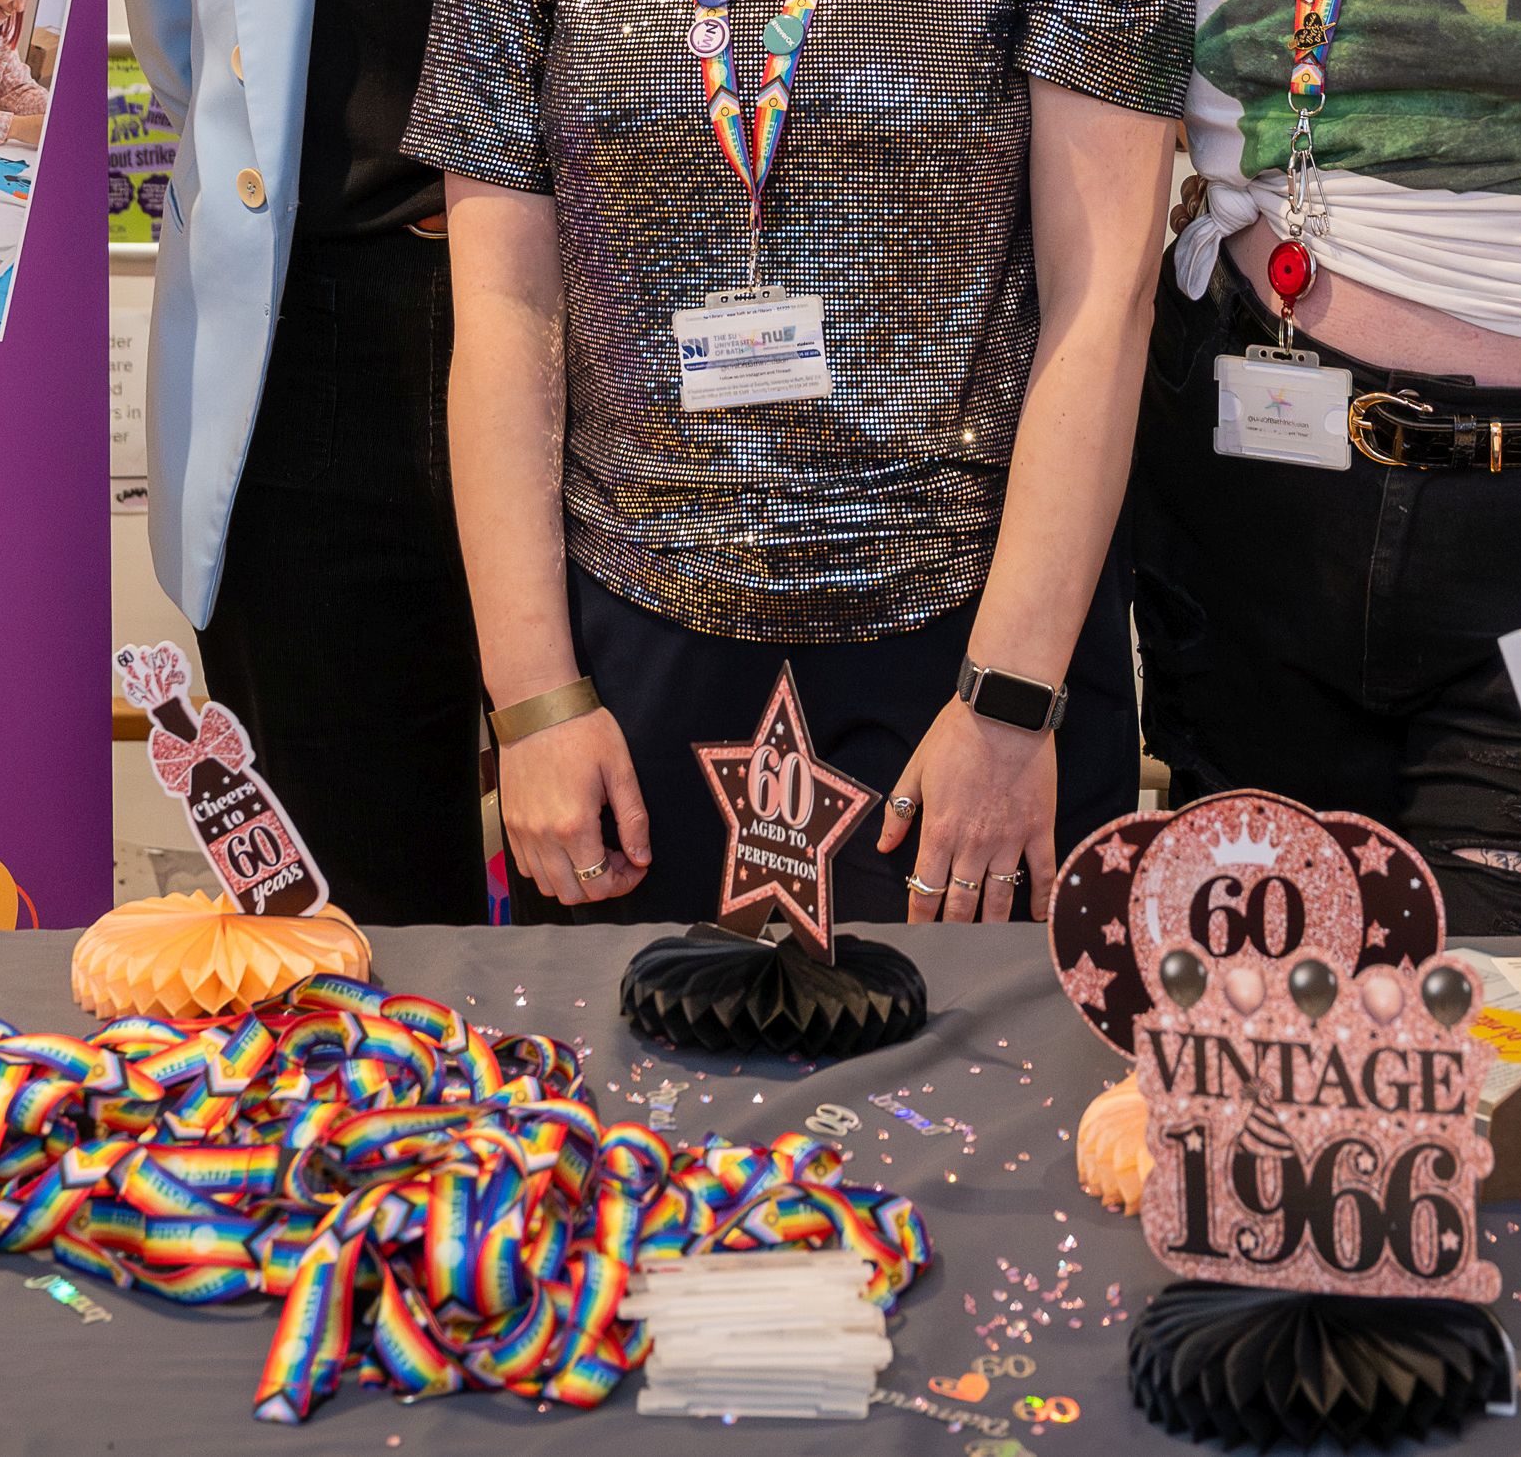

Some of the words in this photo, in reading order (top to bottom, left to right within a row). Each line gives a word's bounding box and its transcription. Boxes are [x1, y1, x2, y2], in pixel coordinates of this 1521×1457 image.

[192, 782, 258, 823] Cheers
[747, 744, 815, 830] 60
[222, 810, 246, 831] to
[749, 818, 787, 843] AGED
[788, 830, 807, 849] TO
[226, 825, 283, 879] 60
[737, 843, 818, 882] PERFECTION
[252, 861, 305, 914] years
[1188, 874, 1307, 959] 60
[1143, 1029, 1467, 1116] VINTAGE
[1164, 1124, 1466, 1279] 1966
